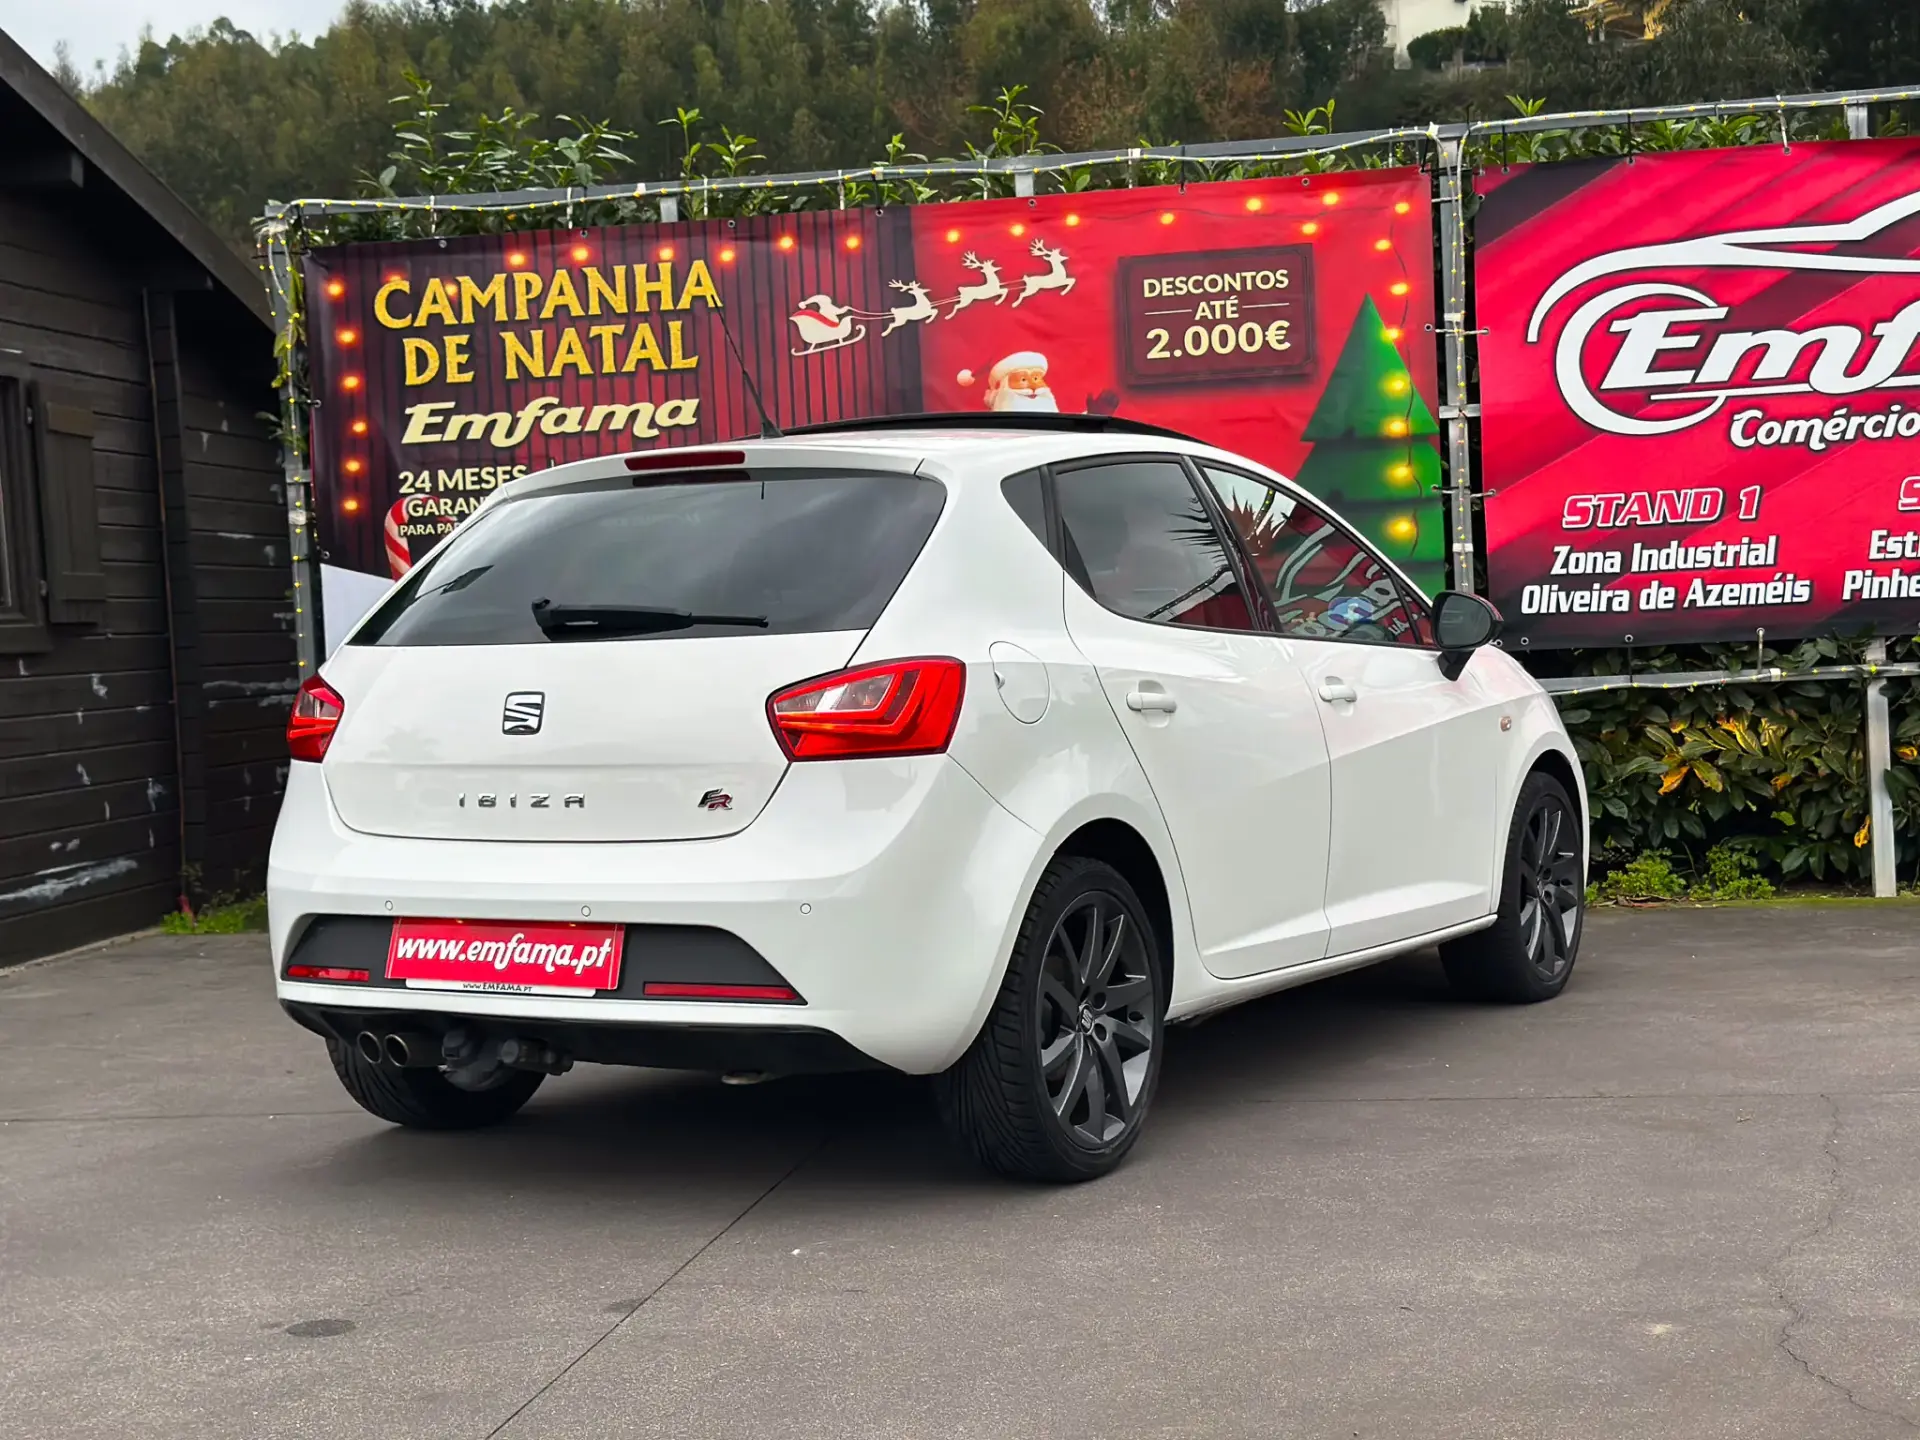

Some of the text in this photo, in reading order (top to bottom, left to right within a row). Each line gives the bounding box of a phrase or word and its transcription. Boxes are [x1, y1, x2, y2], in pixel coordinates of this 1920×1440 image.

[373, 260, 723, 329] CAMPANHA
[1143, 269, 1289, 298] DESCONTOS
[1194, 295, 1239, 320] ATÉ
[403, 320, 699, 386] DE NATAL
[1146, 319, 1291, 359] 2.000€
[401, 396, 700, 448] Emfama
[1730, 404, 1920, 451] Comércio
[398, 470, 432, 494] 24
[1562, 485, 1761, 529] STAND 1
[400, 524, 435, 537] PARA
[1550, 535, 1777, 575] Zona Industrial
[1521, 572, 1811, 615] Oliveira de Azeméis
[458, 793, 586, 809] IBIZA
[396, 933, 612, 975] www.emfama.pt
